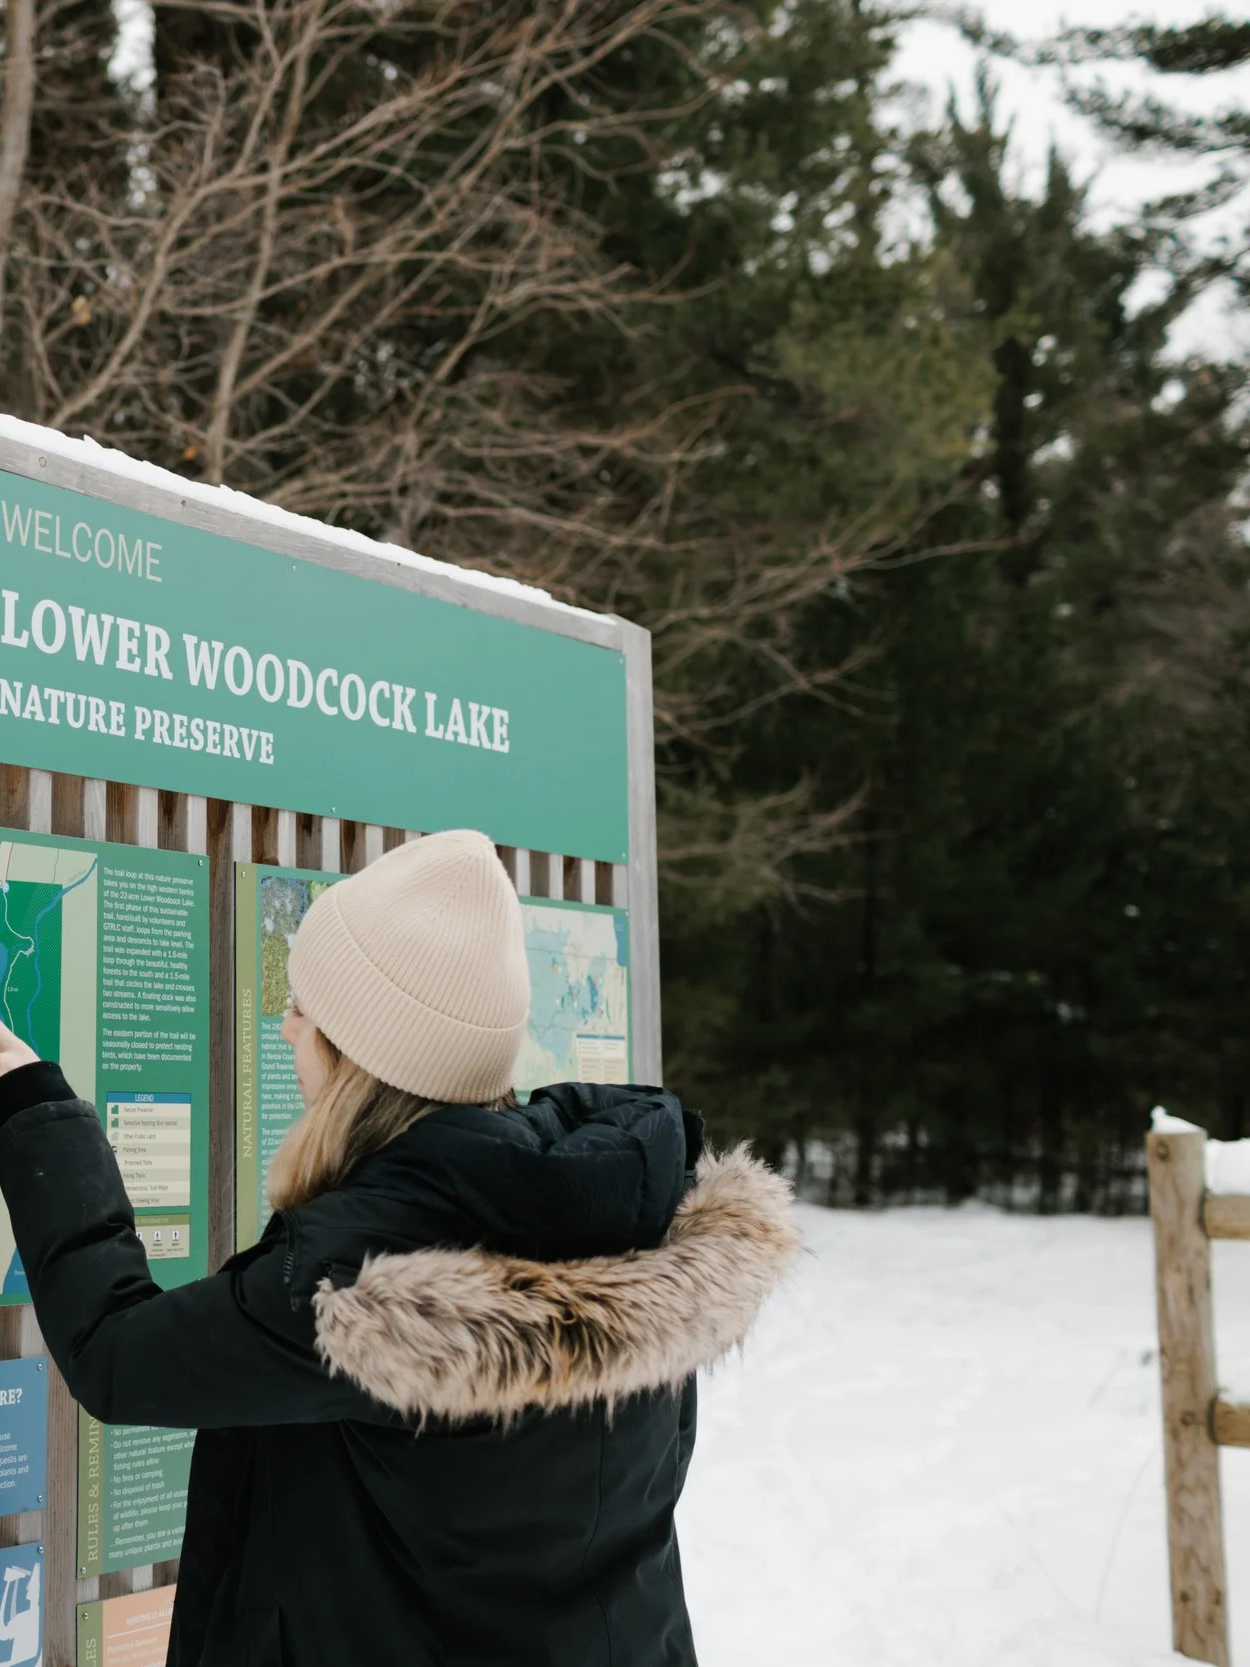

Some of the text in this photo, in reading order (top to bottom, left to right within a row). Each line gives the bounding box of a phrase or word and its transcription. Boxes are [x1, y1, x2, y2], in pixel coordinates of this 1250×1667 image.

[2, 500, 162, 582] WELCOME
[1, 589, 510, 754] LOWER WOODCOCK LAKE
[134, 706, 274, 764] PRESERVE
[104, 867, 114, 875] The
[114, 869, 125, 877] trail
[126, 871, 137, 879] loop
[104, 900, 113, 908] The
[242, 989, 252, 1158] NATURAL FEATURES
[135, 1094, 154, 1102] LEGEND
[18, 1465, 28, 1474] and
[89, 1483, 99, 1497] &
[88, 1503, 99, 1561] RULES
